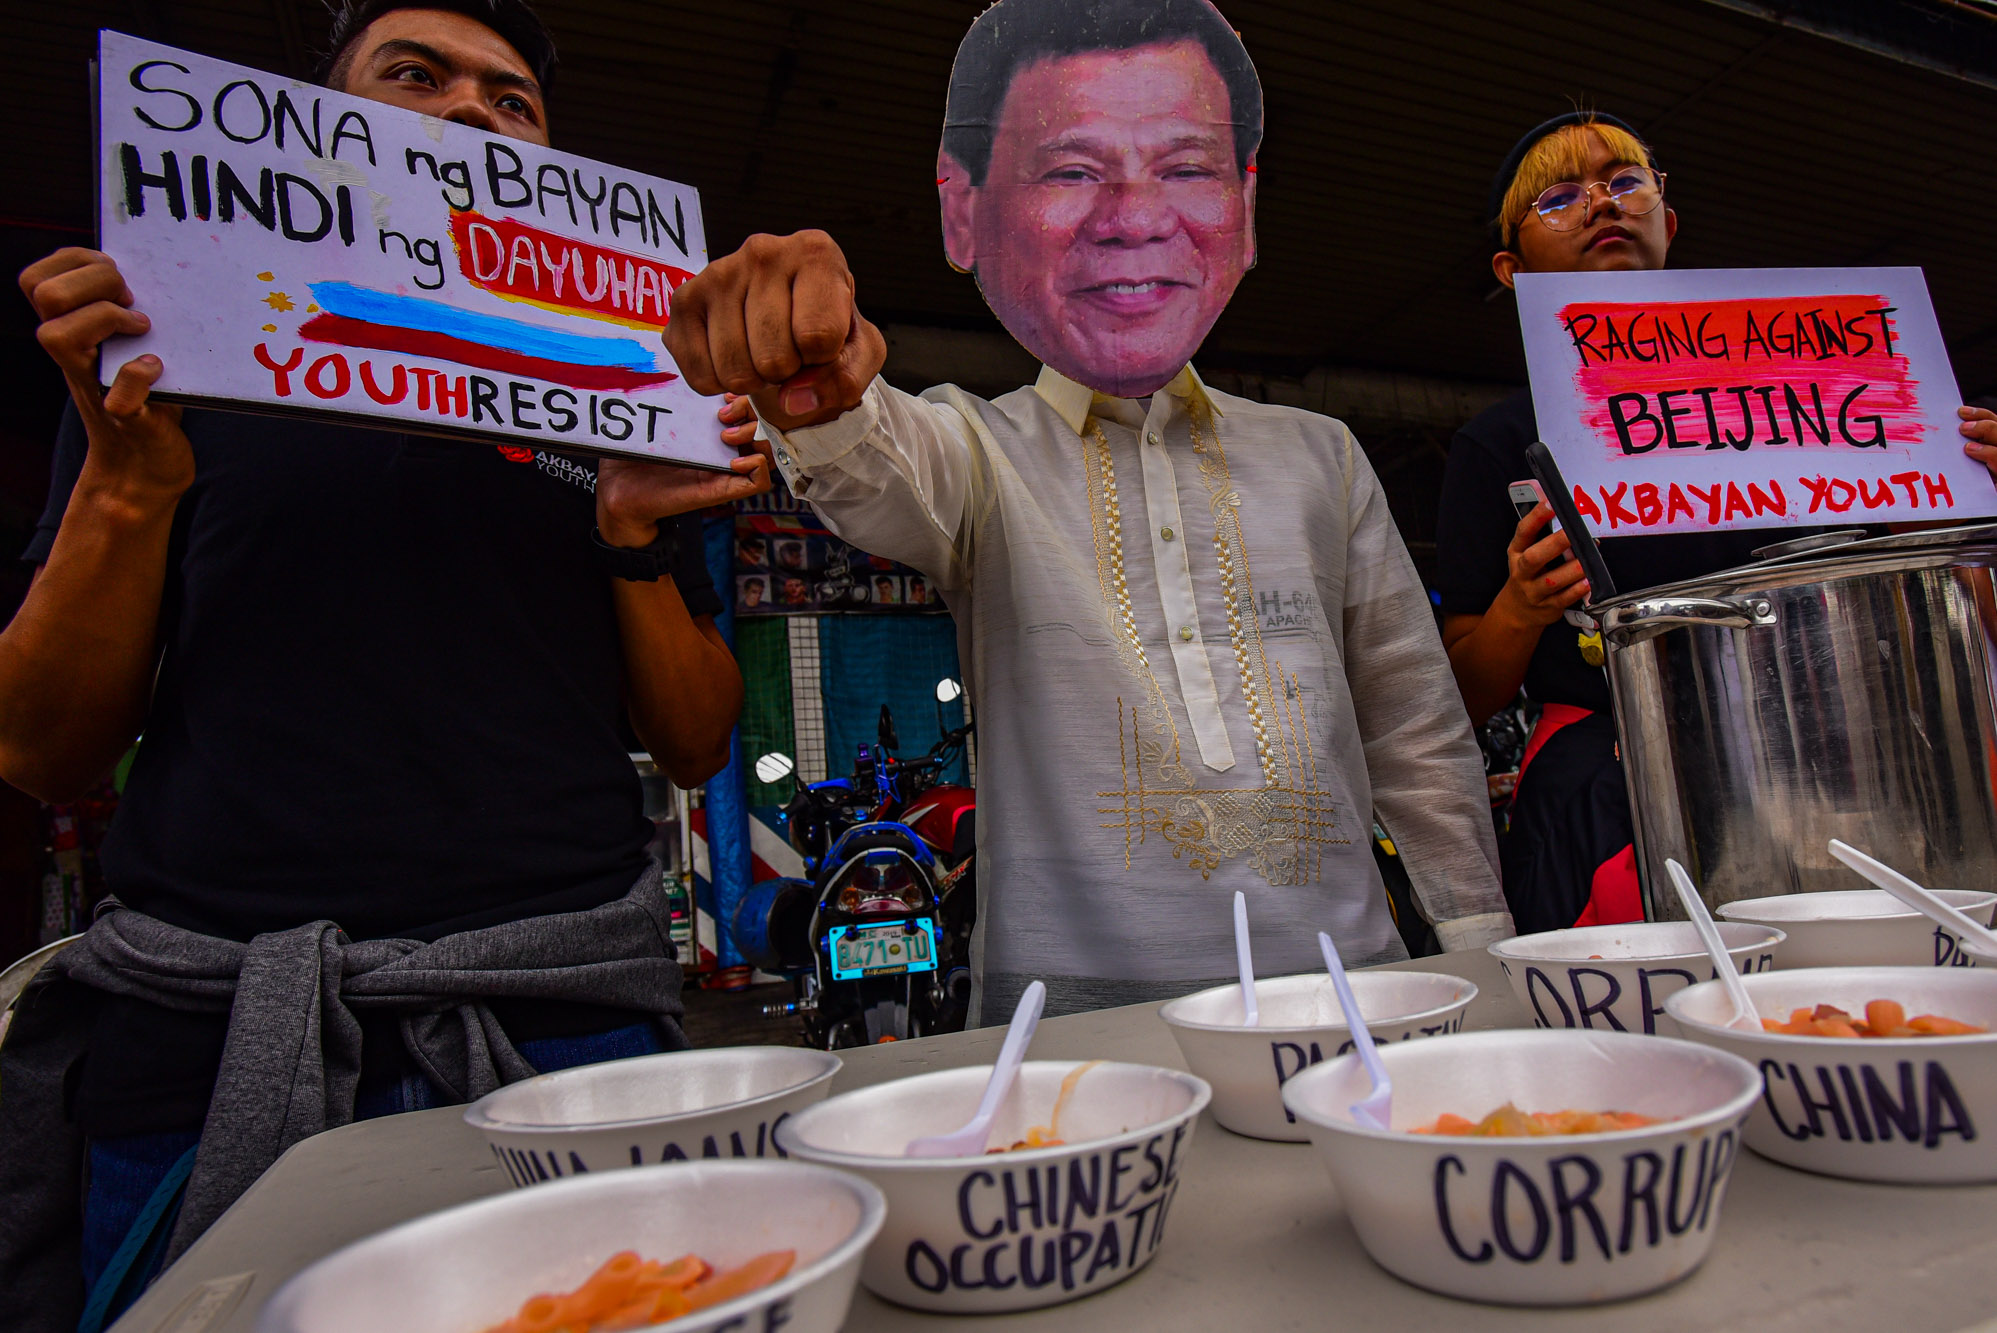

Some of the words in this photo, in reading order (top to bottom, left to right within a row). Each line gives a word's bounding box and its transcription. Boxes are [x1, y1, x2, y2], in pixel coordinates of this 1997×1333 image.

[128, 60, 376, 167] SONA
[404, 146, 474, 212] ng
[484, 141, 689, 257] BAYAN
[122, 142, 354, 246] HINDI
[380, 230, 445, 290] ng
[1563, 311, 1730, 368] RAGING
[1743, 307, 1899, 363] AGAINST
[1607, 382, 1888, 456] BEIJING
[535, 450, 597, 484] AKBAY
[536, 459, 595, 494] YOUTH
[1573, 479, 1788, 530] AKBAYAN
[1799, 470, 1955, 515] YOUTH
[902, 935, 928, 961] TU
[1760, 1058, 1977, 1149] CHINA
[958, 1117, 1190, 1240] CHINESE
[1434, 1116, 1748, 1264] CORRUP
[905, 1180, 1180, 1294] OCCUPATI
